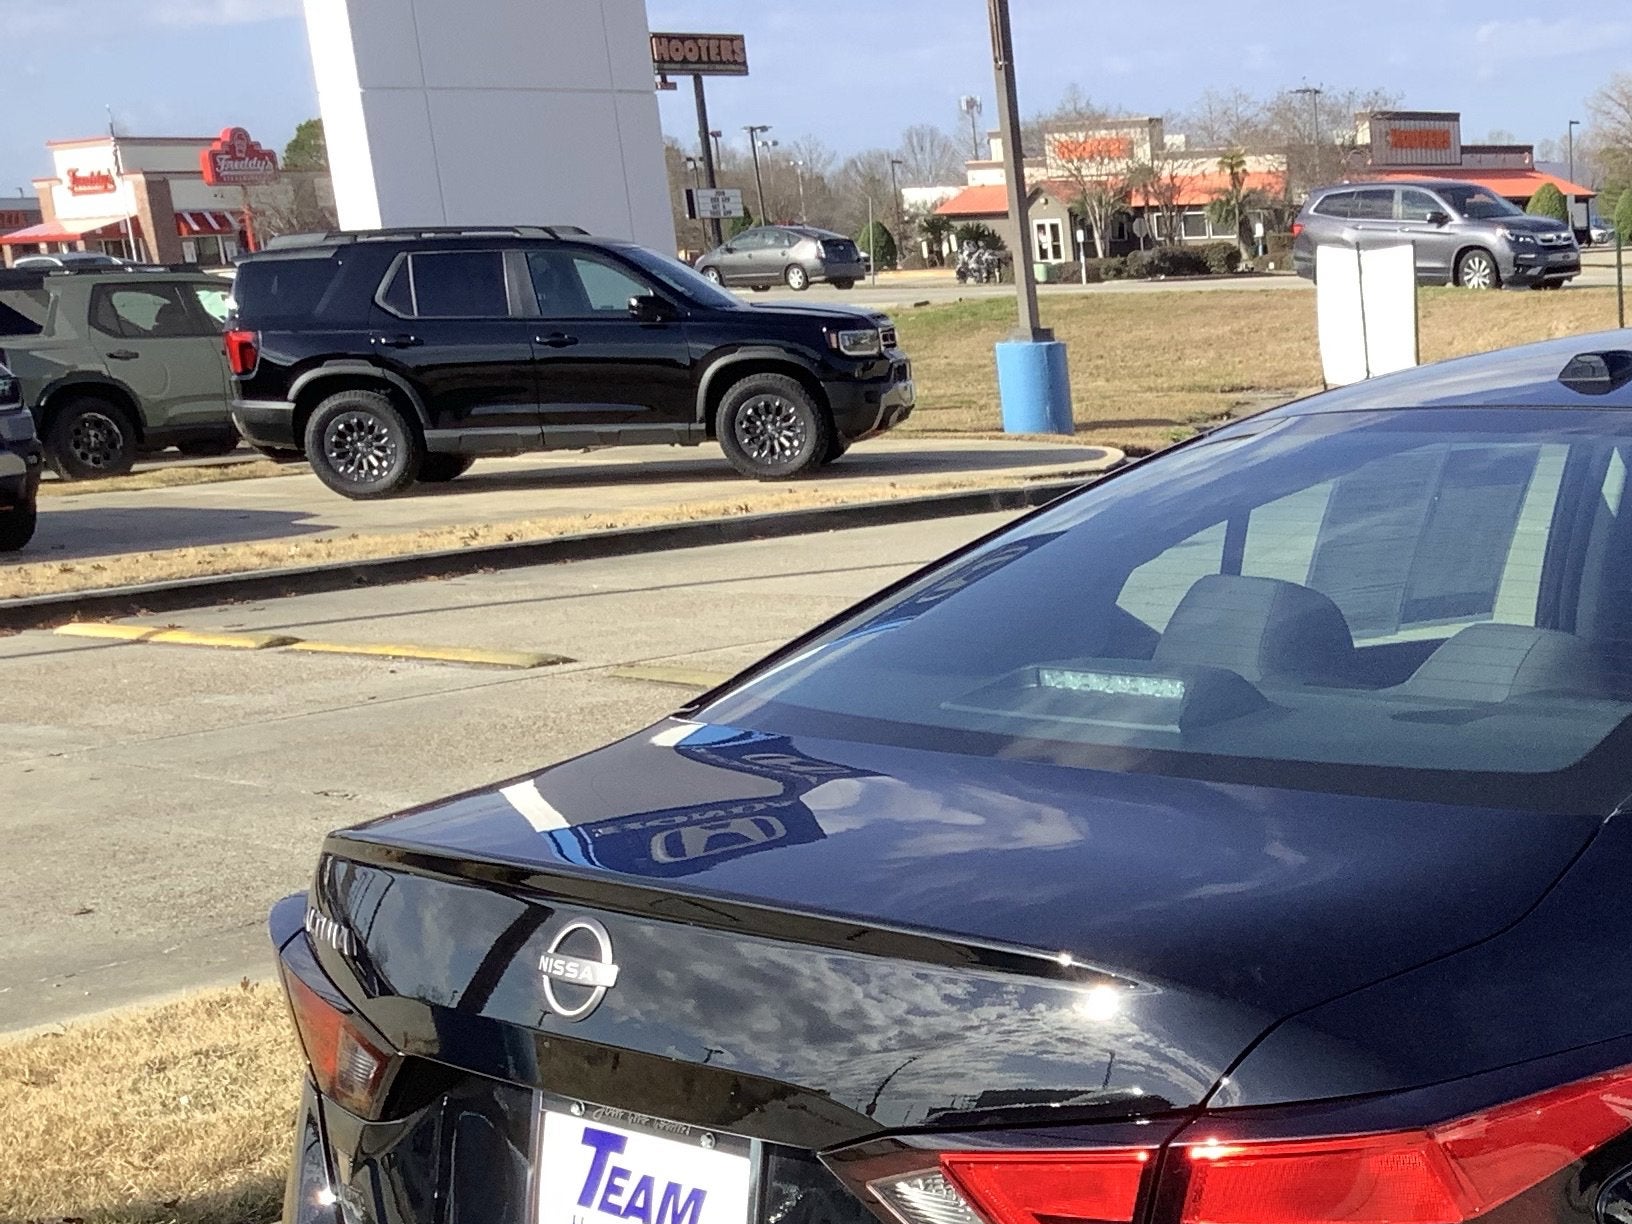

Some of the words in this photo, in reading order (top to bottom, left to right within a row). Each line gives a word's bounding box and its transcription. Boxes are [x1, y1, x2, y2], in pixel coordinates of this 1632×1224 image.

[652, 37, 745, 62] HOOTERS
[216, 154, 274, 174] Freddy's
[538, 954, 611, 985] NISSA
